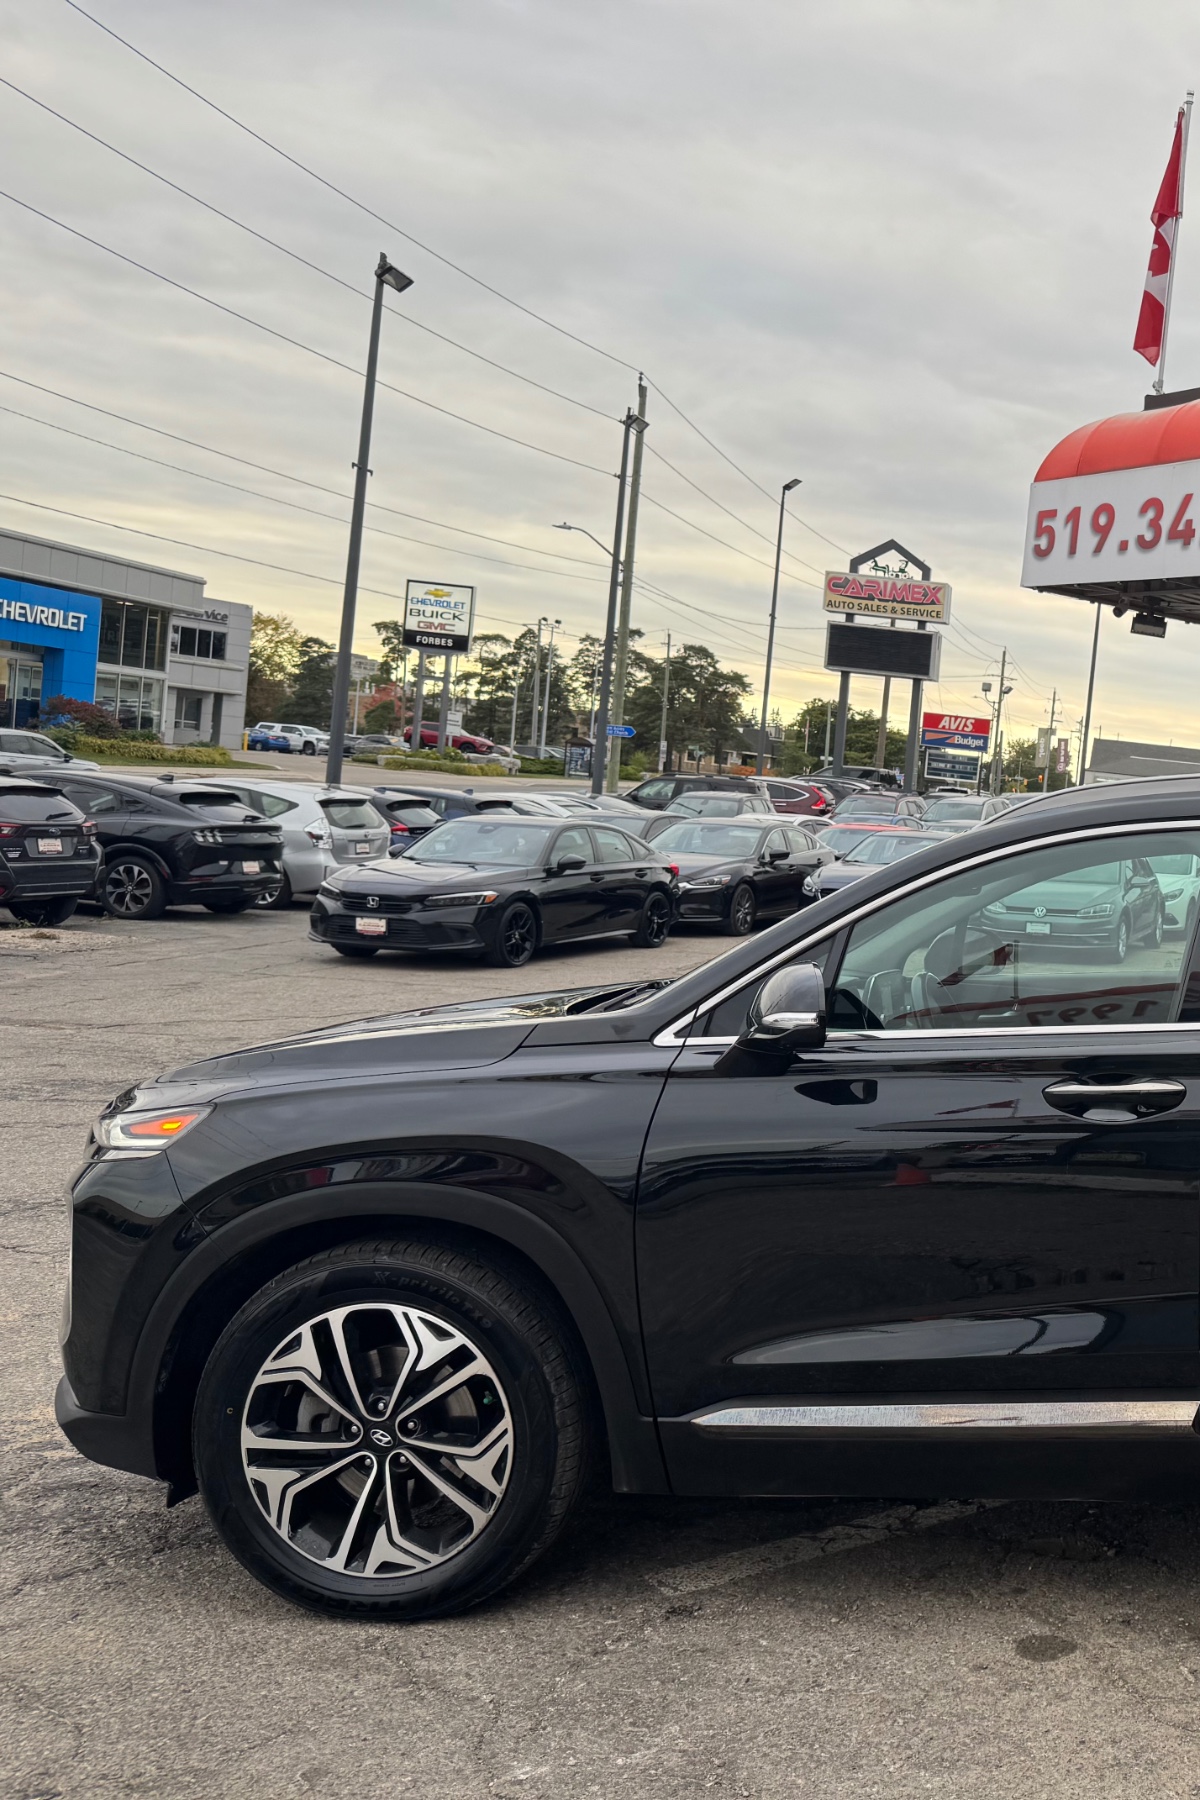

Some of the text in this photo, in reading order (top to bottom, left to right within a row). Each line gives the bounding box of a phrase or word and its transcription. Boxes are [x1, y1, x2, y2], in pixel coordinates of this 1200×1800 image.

[826, 576, 943, 605] CARIMEX
[410, 597, 466, 610] CHEVROLET
[826, 599, 942, 619] AUTO SALES & SERVICE
[409, 608, 465, 622] BUICK
[417, 620, 456, 632] GMC
[415, 635, 454, 647] FORBES
[937, 715, 976, 732] AVIS
[954, 734, 984, 748] Budget
